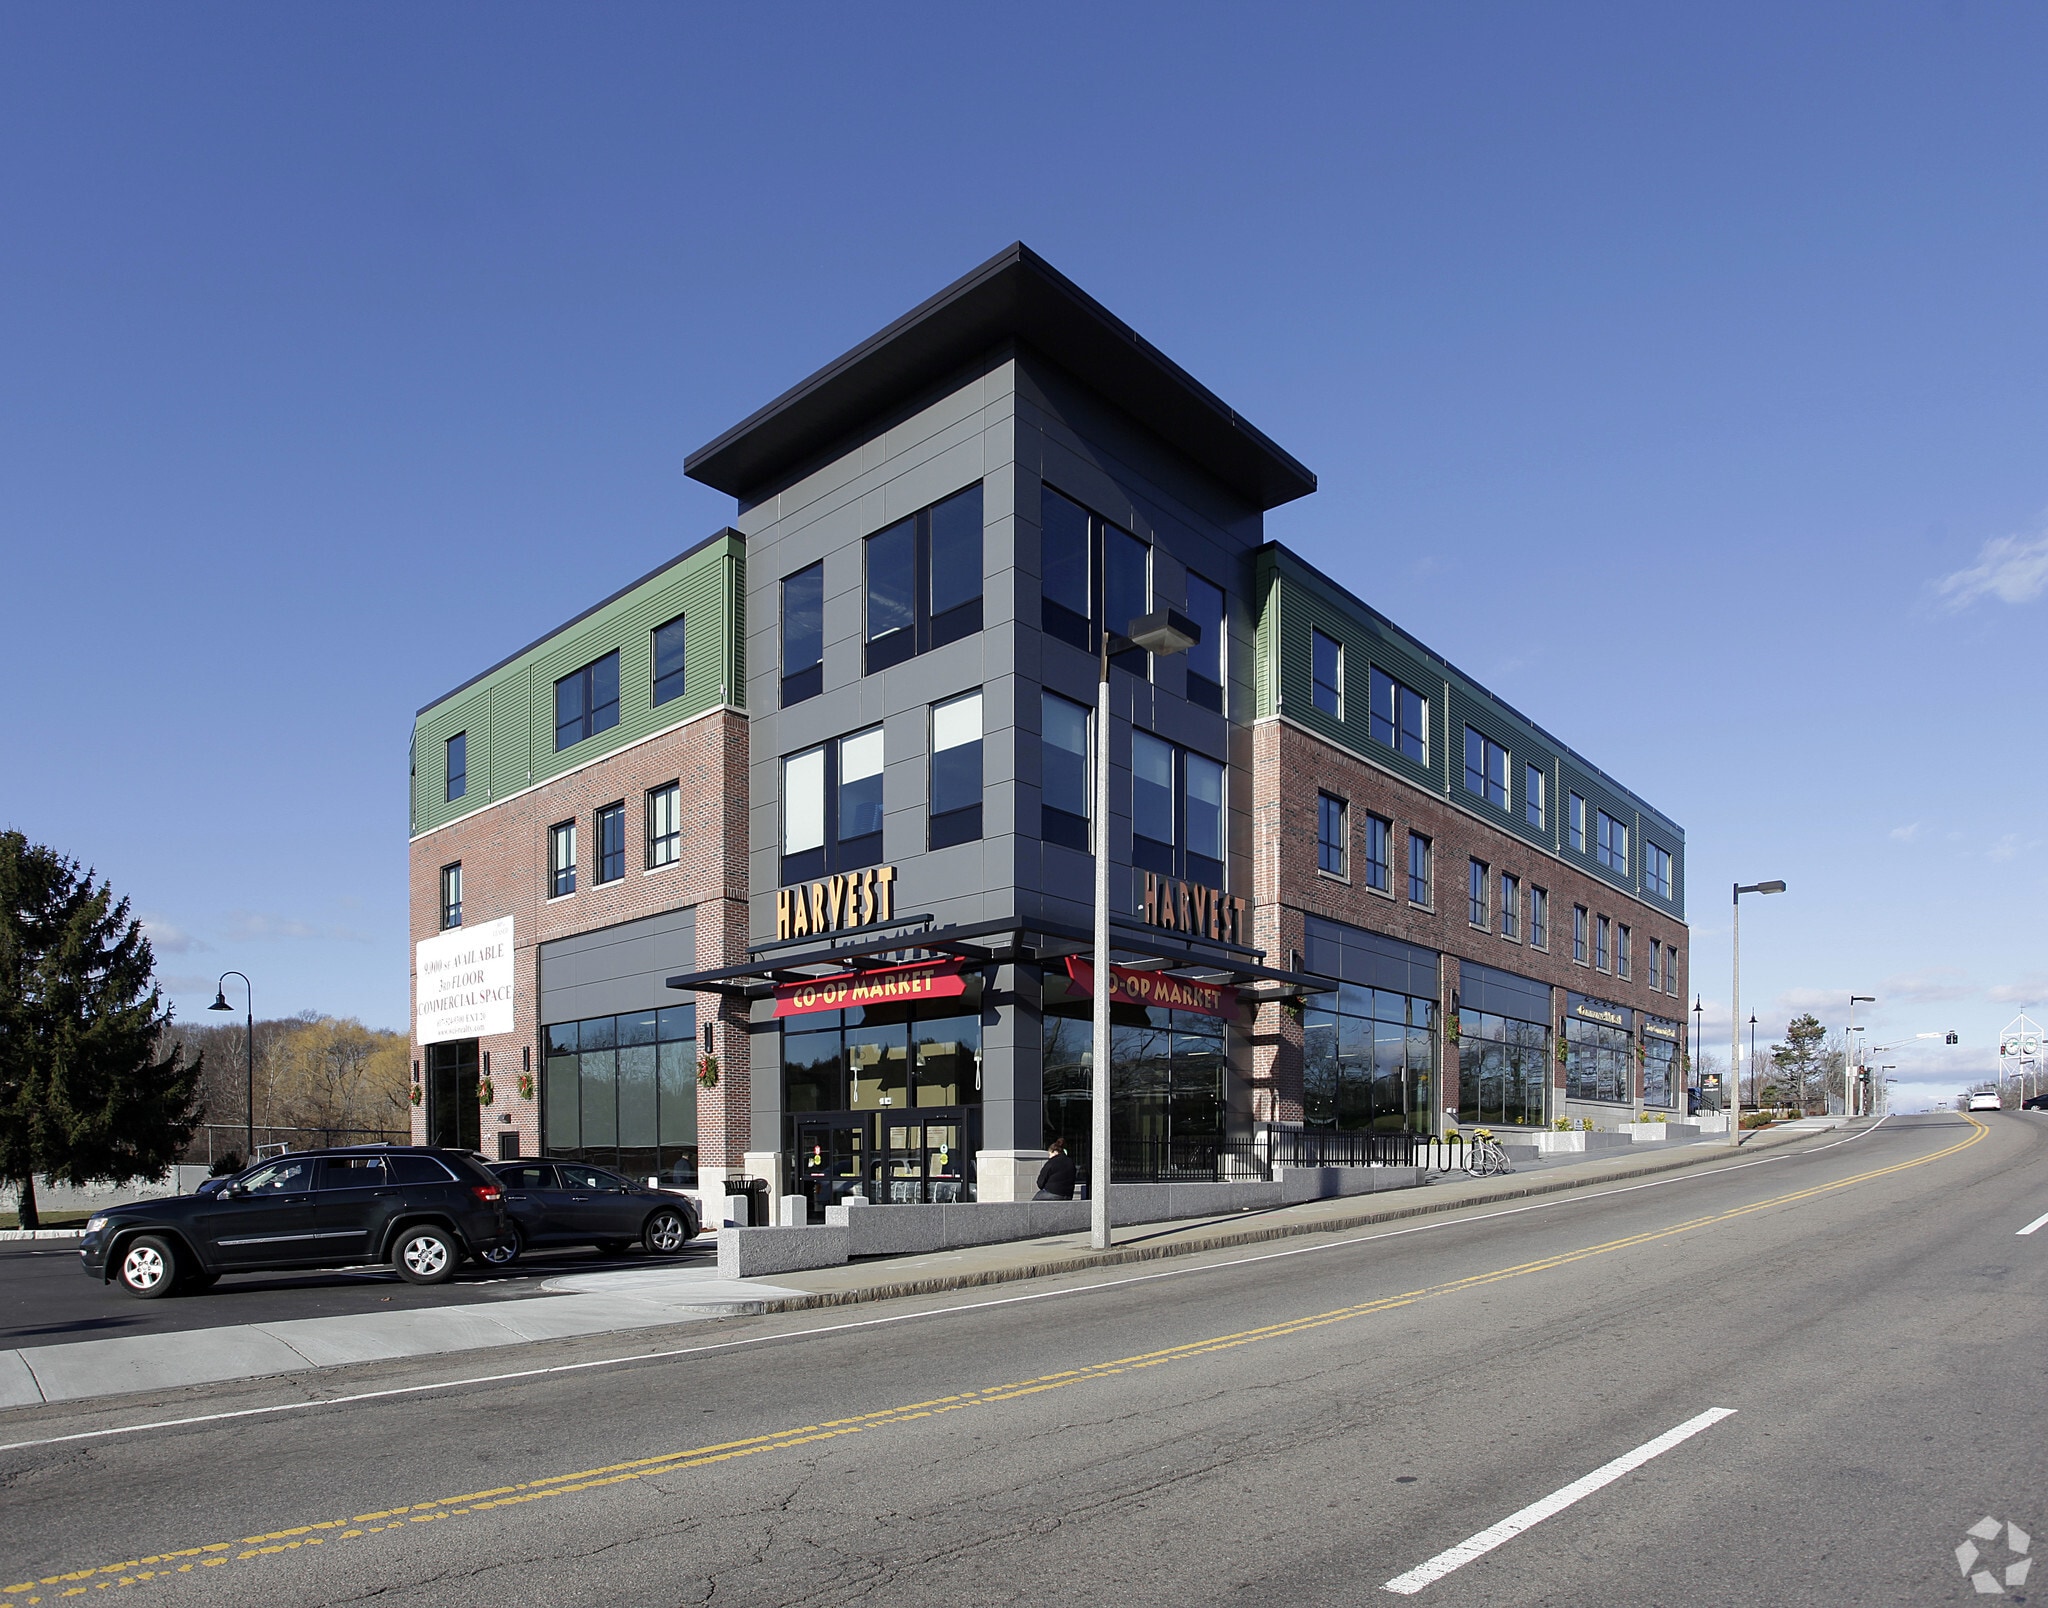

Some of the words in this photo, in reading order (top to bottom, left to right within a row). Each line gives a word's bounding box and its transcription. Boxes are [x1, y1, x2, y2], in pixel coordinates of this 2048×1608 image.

[776, 866, 897, 941] HARVEST
[1142, 870, 1246, 945] HARVEST
[454, 943, 504, 967] AVAILABLE
[452, 970, 484, 989] FLOOR
[793, 982, 848, 1008] CO-OP
[852, 969, 935, 1001] MARKET
[1109, 972, 1151, 999] O-OP
[1153, 980, 1222, 1010] MARKET
[418, 991, 479, 1016] COMMERCIAL
[480, 985, 511, 1004] SPACE
